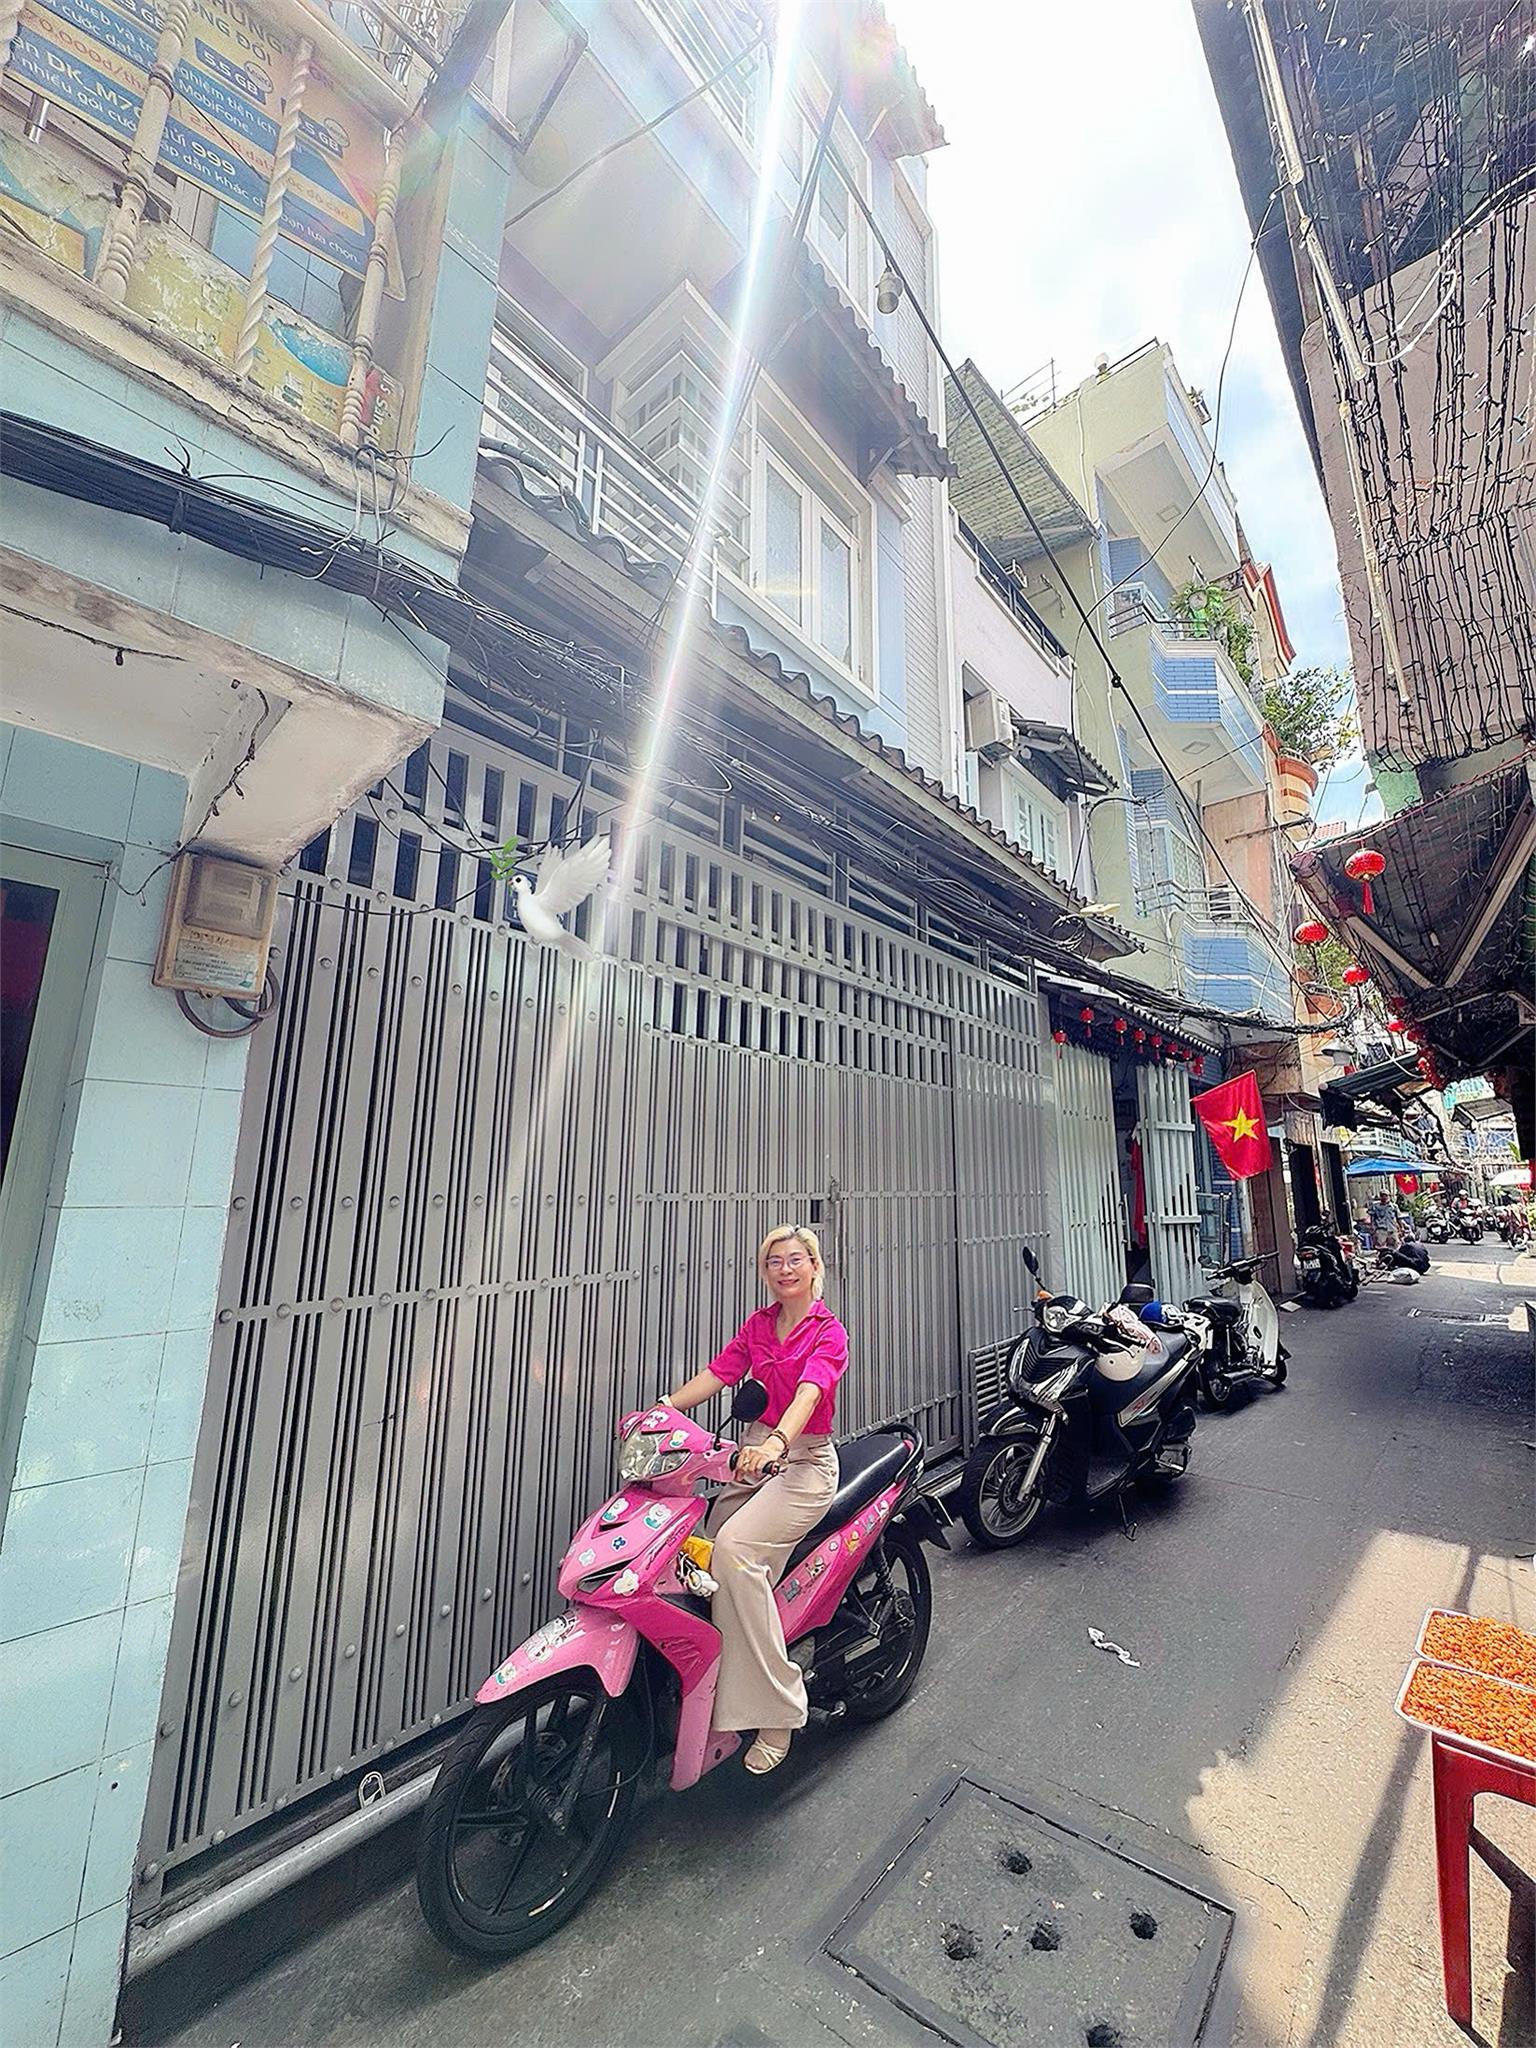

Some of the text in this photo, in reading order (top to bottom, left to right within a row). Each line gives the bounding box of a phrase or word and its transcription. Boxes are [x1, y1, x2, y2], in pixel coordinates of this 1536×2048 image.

[192, 0, 230, 37] NG
[139, 37, 157, 57] tr
[203, 50, 232, 77] 5.5
[234, 72, 259, 96] GB
[191, 140, 236, 177] 999
